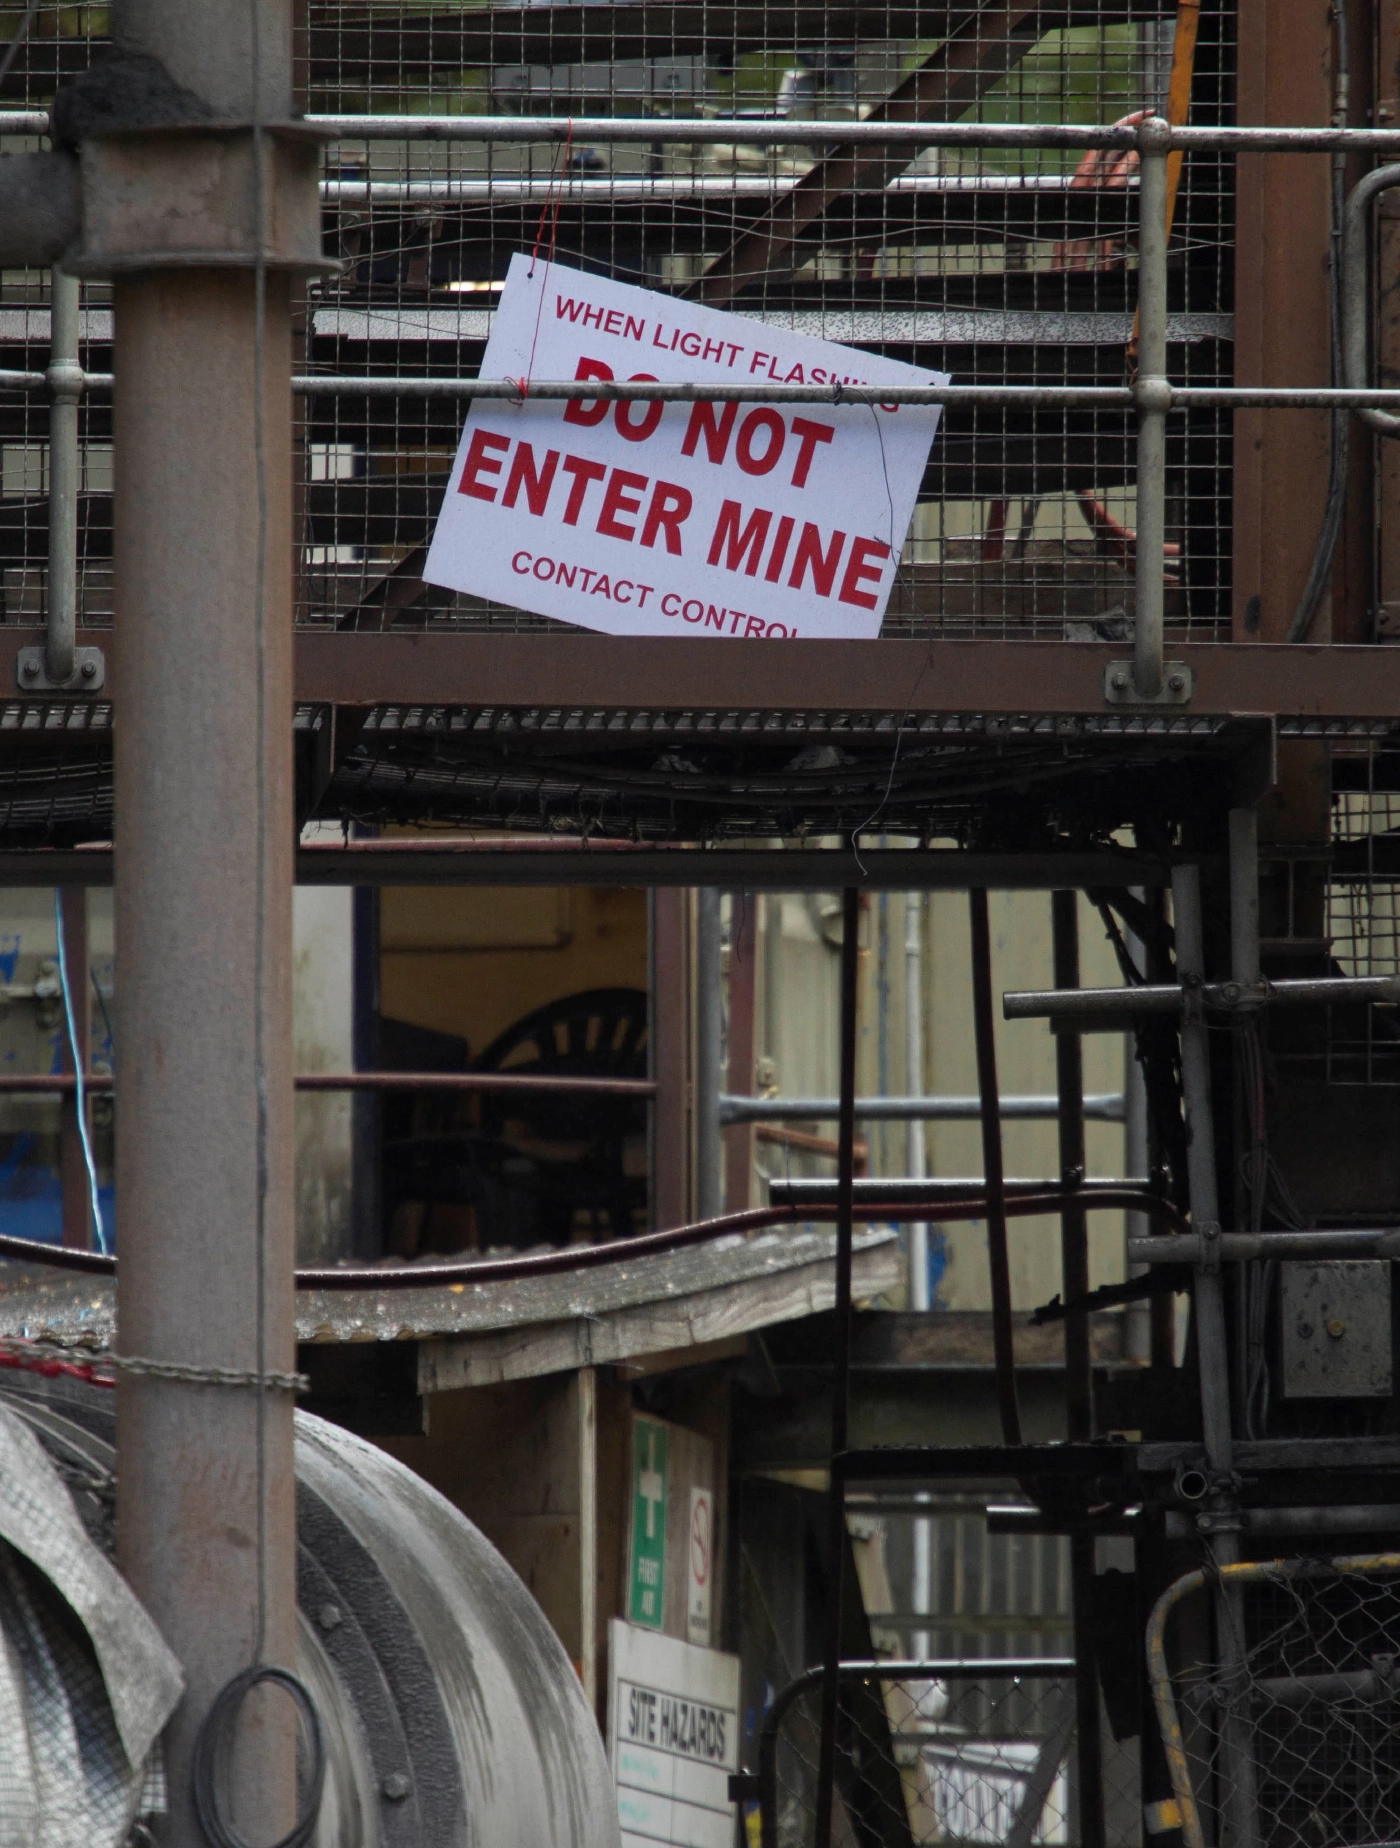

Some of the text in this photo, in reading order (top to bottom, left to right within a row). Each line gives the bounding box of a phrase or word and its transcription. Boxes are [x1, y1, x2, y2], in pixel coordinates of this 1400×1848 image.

[556, 294, 900, 413] WHEN LIGHT FLAS
[563, 356, 835, 489] DO NOT
[457, 428, 891, 611] ENTER MINE
[511, 551, 654, 608] CONTACT
[628, 1688, 726, 1762] SITE HAZARDS
